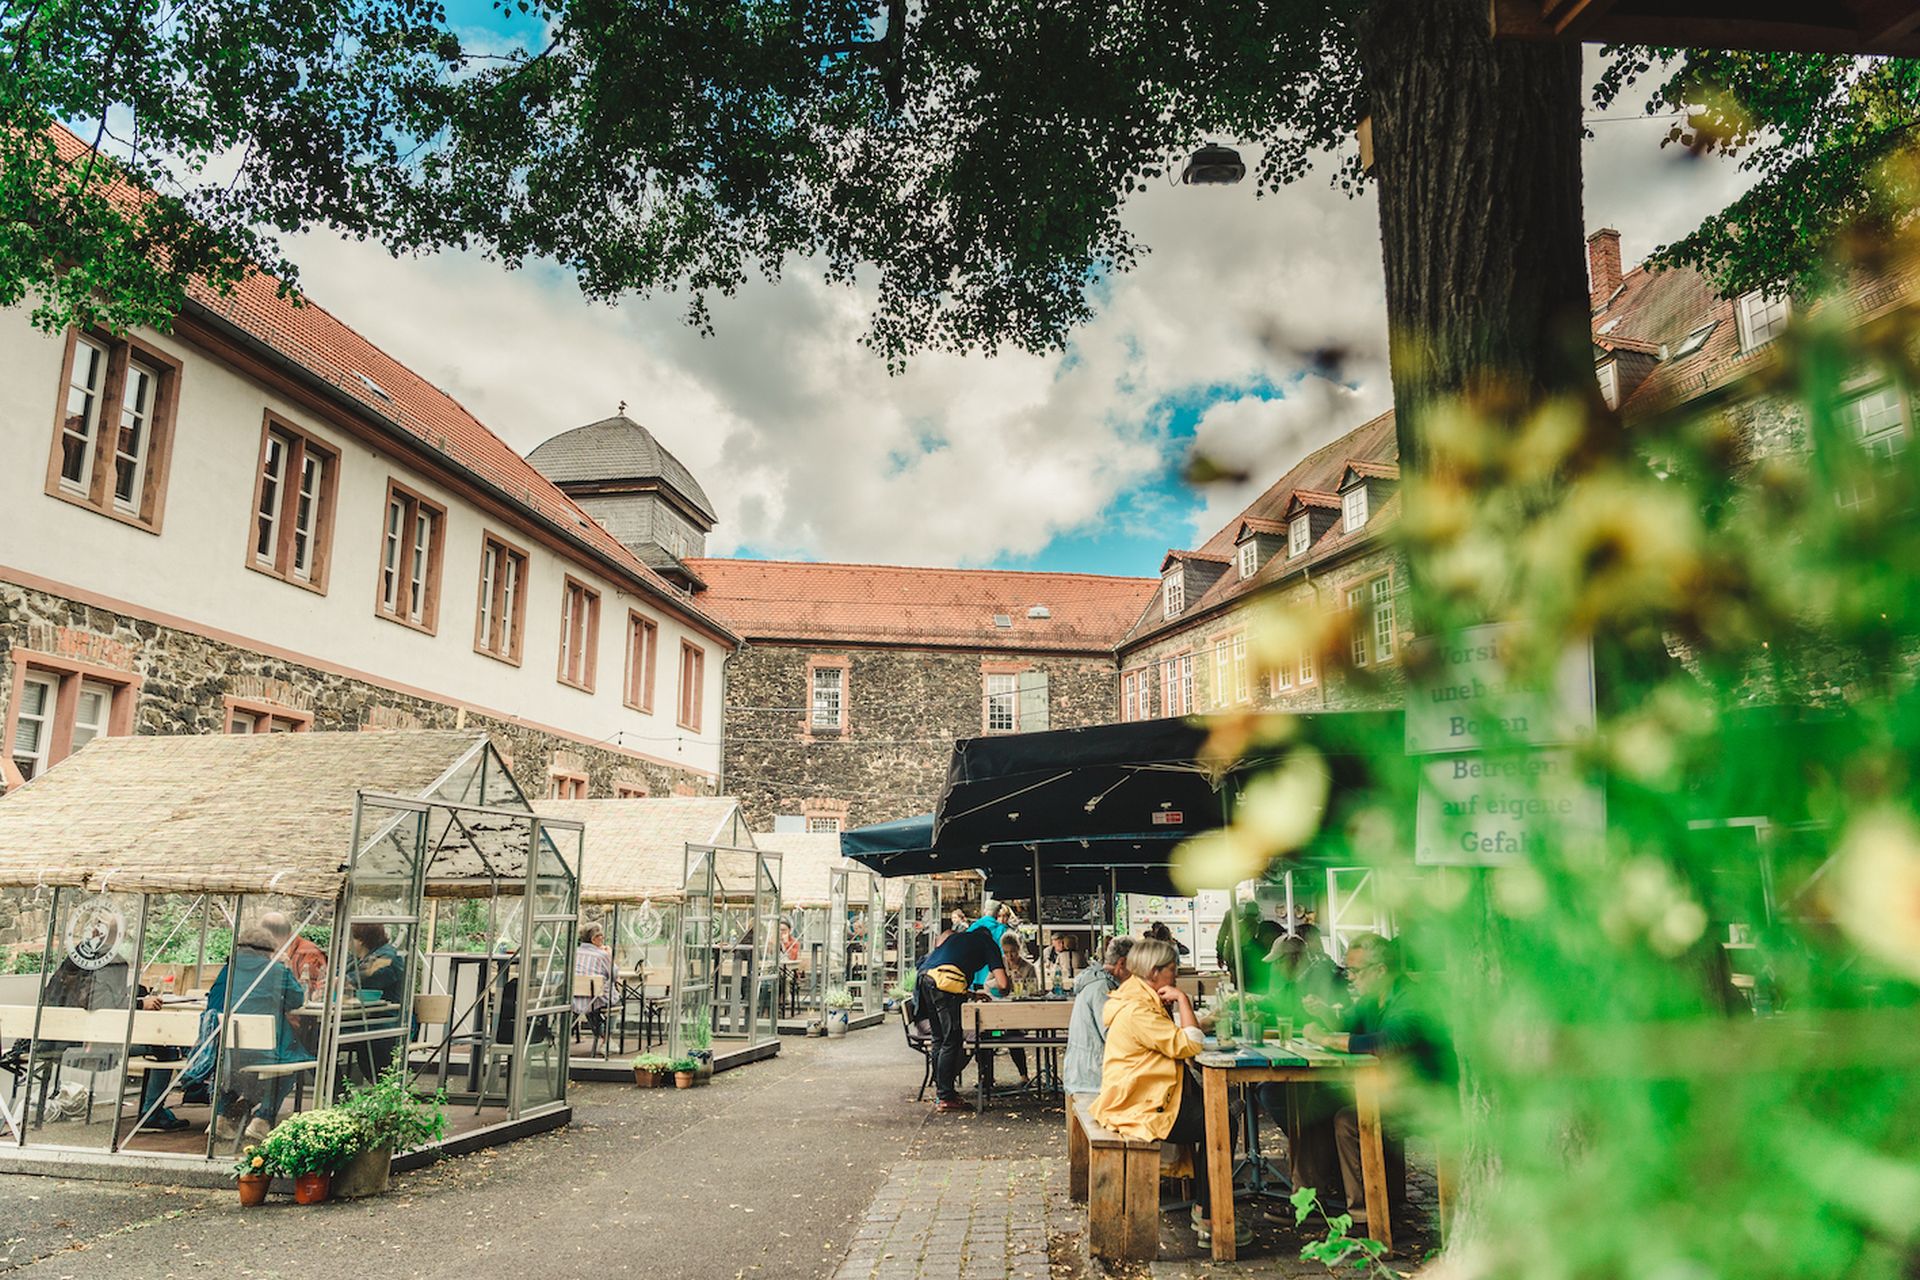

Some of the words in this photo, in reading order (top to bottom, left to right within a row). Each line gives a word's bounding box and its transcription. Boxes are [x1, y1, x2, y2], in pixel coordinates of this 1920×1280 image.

[1439, 636, 1524, 665] Vorsi
[1442, 794, 1480, 816] auf
[1460, 830, 1537, 854] Gefa
